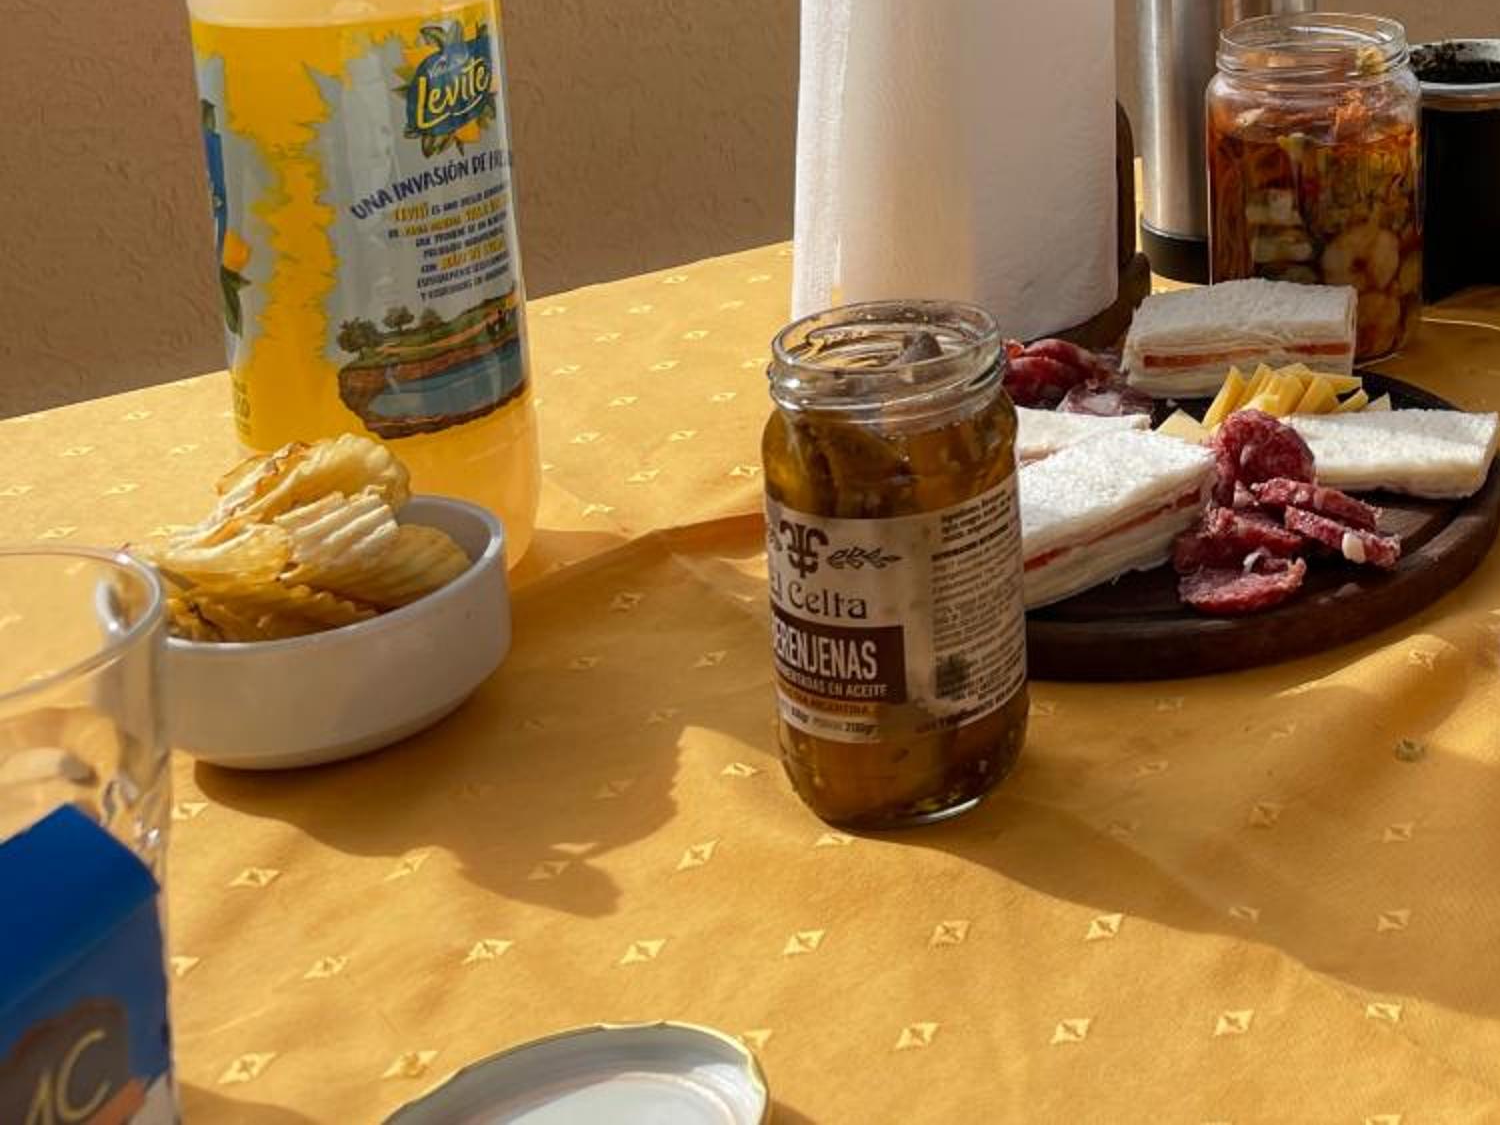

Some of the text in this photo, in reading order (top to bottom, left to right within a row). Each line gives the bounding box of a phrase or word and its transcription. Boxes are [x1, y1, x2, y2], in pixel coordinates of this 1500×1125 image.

[350, 188, 393, 221] UNA
[392, 158, 469, 202] INVASIÓN
[788, 580, 867, 619] Celta
